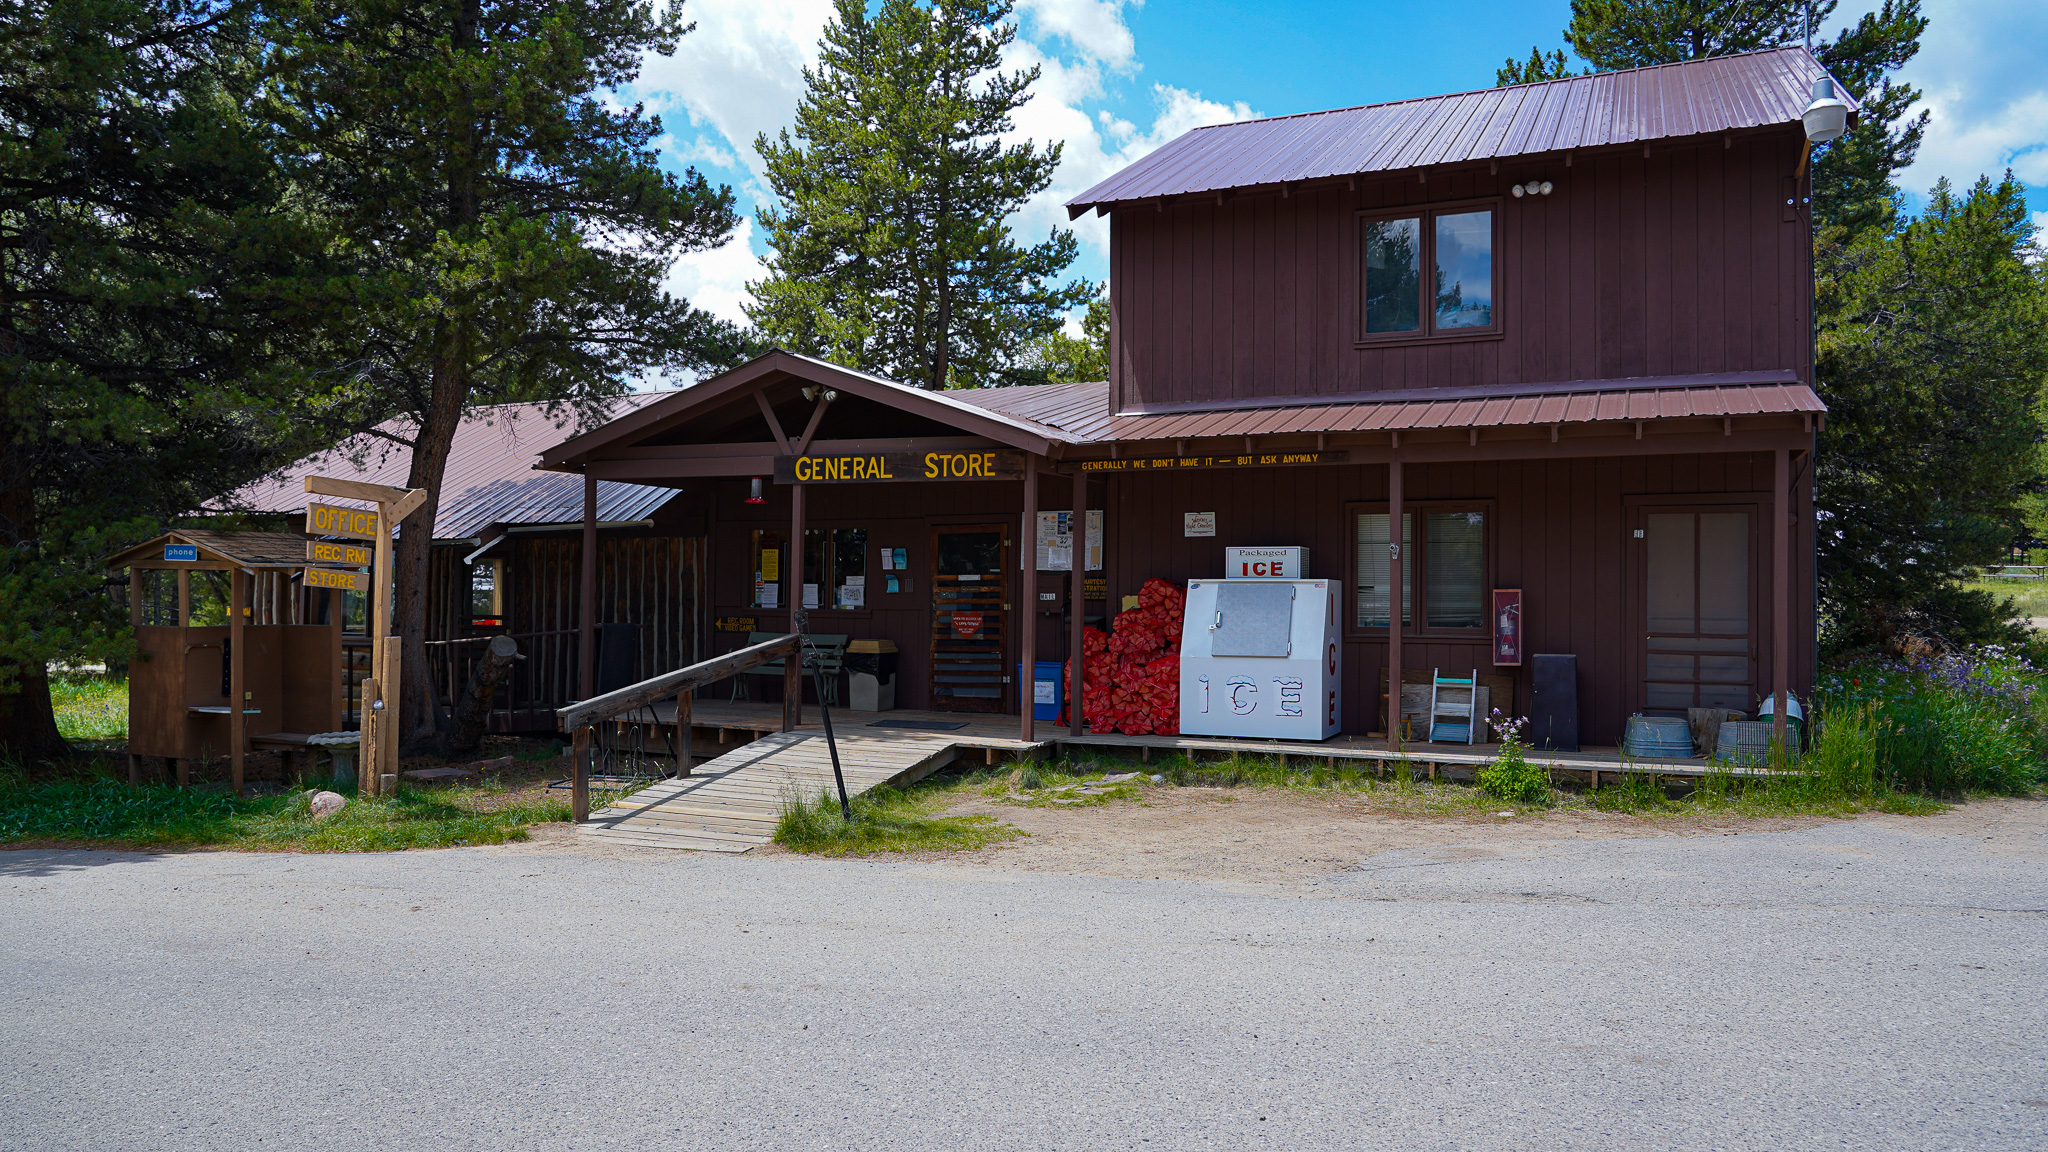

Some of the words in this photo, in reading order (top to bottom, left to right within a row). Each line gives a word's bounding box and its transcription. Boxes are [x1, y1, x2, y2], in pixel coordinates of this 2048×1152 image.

[795, 456, 893, 481] GENERAL
[924, 452, 996, 478] STORE
[1081, 460, 1127, 471] GENERALLY
[1133, 459, 1146, 469] WE
[1152, 458, 1174, 468] DON'T
[1179, 457, 1199, 467] HAVE
[1205, 457, 1213, 466] IT
[1237, 456, 1252, 466] BUT
[1260, 455, 1277, 465] ASK
[1282, 453, 1319, 464] ANYWAY
[315, 506, 377, 536] OFFICE
[168, 548, 194, 557] phone
[314, 544, 342, 561] REC.
[346, 548, 367, 564] RM.
[1239, 549, 1287, 557] Packaged
[1242, 561, 1283, 576] ICE
[309, 570, 357, 589] STORE
[1328, 593, 1336, 726] ICE
[1198, 674, 1303, 717] ICE
